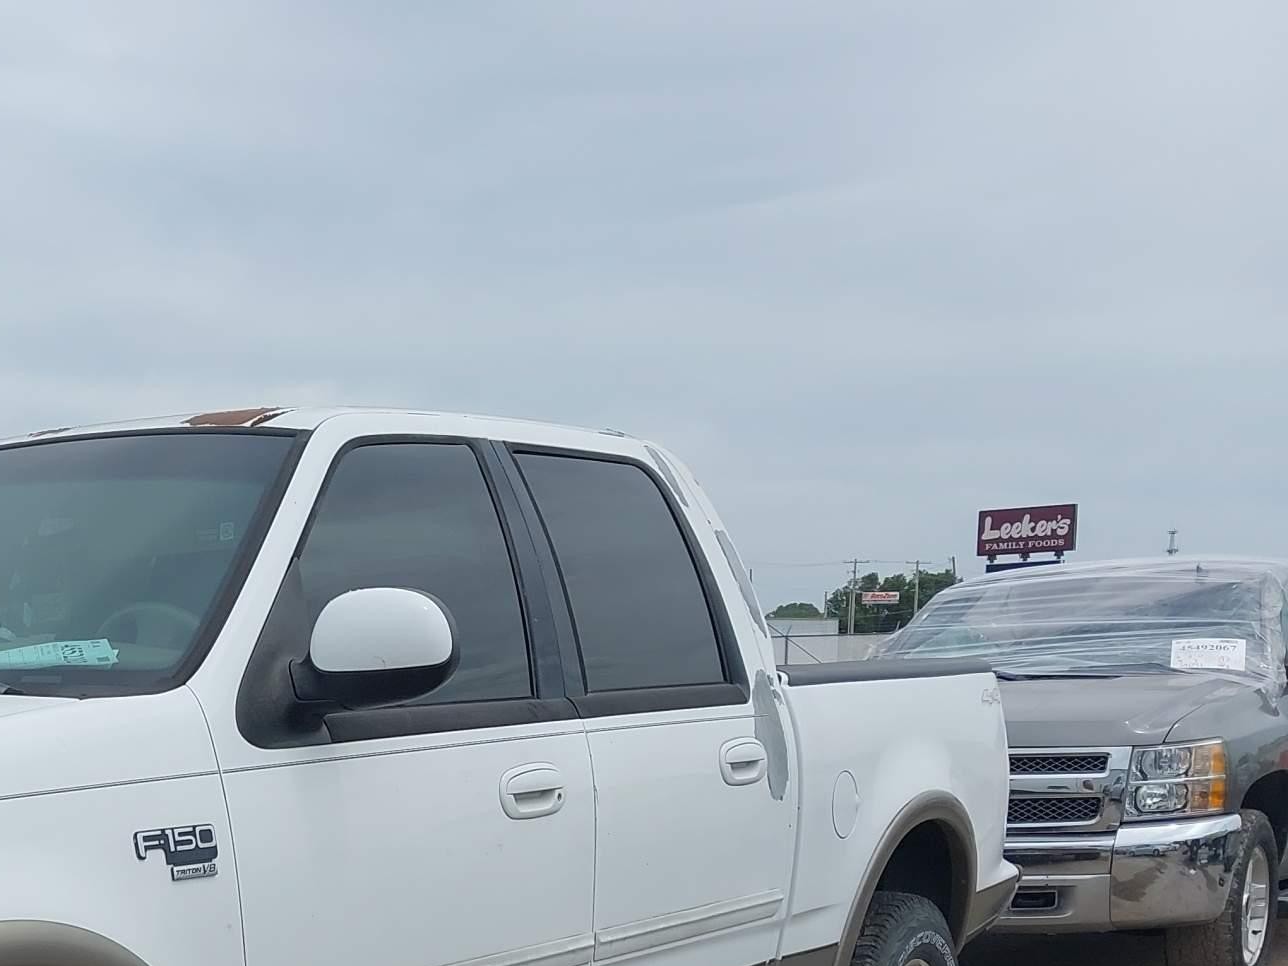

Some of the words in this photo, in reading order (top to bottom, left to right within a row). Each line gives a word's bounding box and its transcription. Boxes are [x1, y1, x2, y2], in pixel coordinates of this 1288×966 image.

[981, 513, 1071, 540] Leeker's
[985, 541, 1026, 551] FAMILY
[1028, 538, 1065, 548] FOODS
[134, 824, 218, 860] F-150
[175, 866, 202, 877] TRITON
[201, 863, 217, 875] V8
